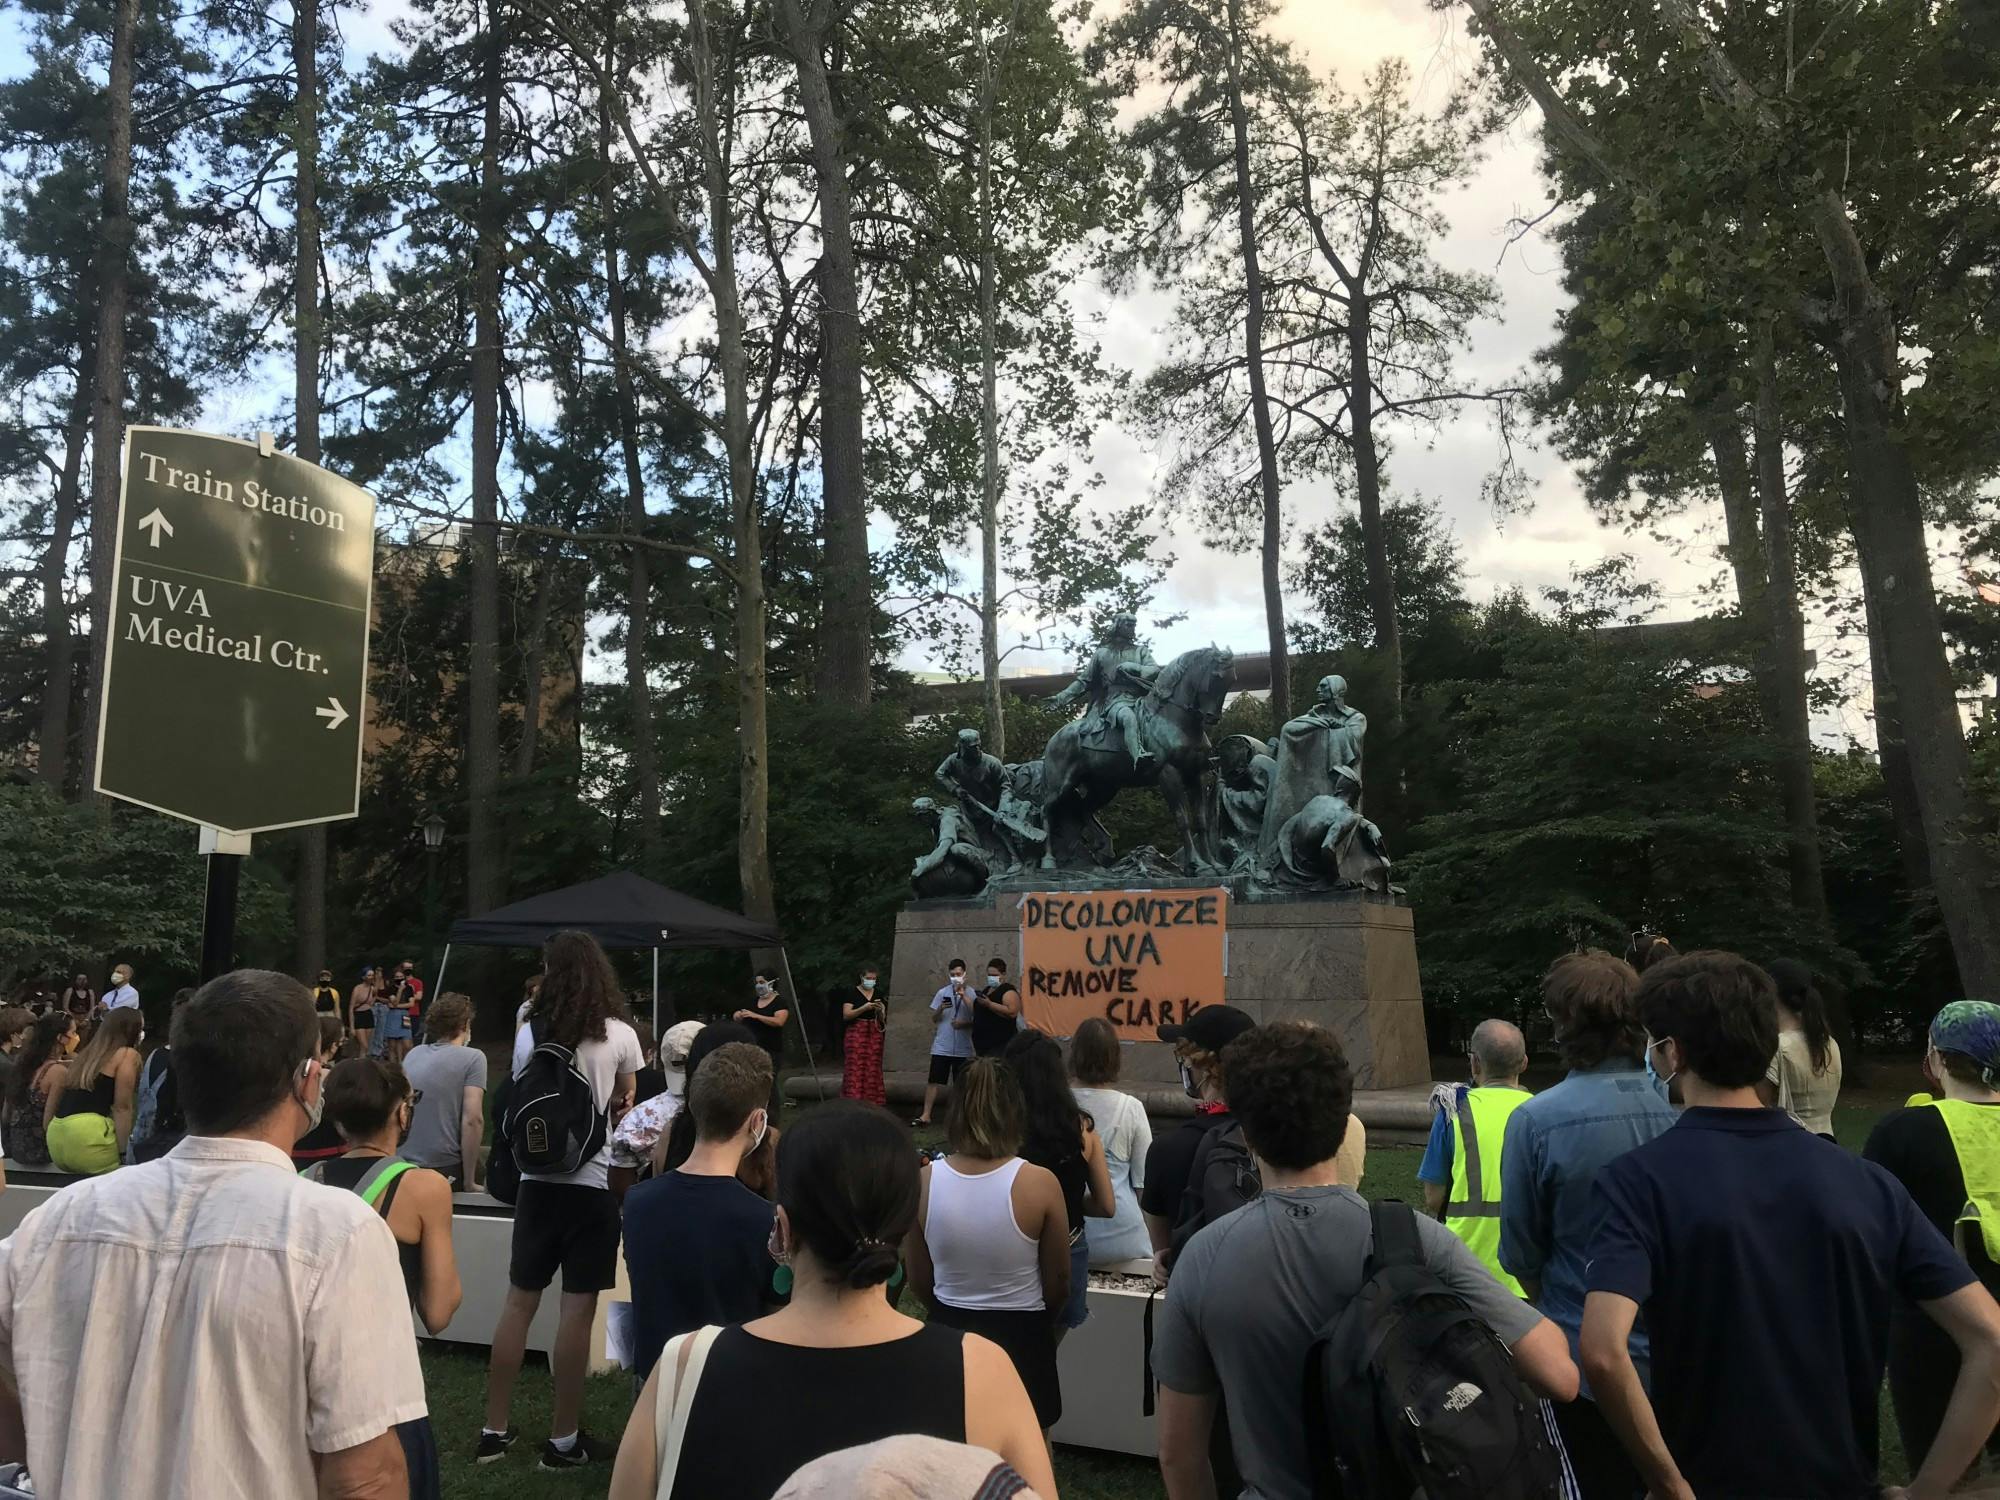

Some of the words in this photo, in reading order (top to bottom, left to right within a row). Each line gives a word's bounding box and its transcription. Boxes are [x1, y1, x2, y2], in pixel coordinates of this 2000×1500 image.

[140, 451, 234, 503] Train
[242, 481, 345, 532] Station
[130, 575, 211, 618] UVA
[124, 613, 262, 663] Medical
[270, 640, 329, 675] Ctr.
[1027, 896, 1218, 931] DECOLONIZE
[1086, 932, 1162, 966] UVA
[1029, 966, 1138, 998] REMOVE
[1106, 997, 1200, 1027] CLARK
